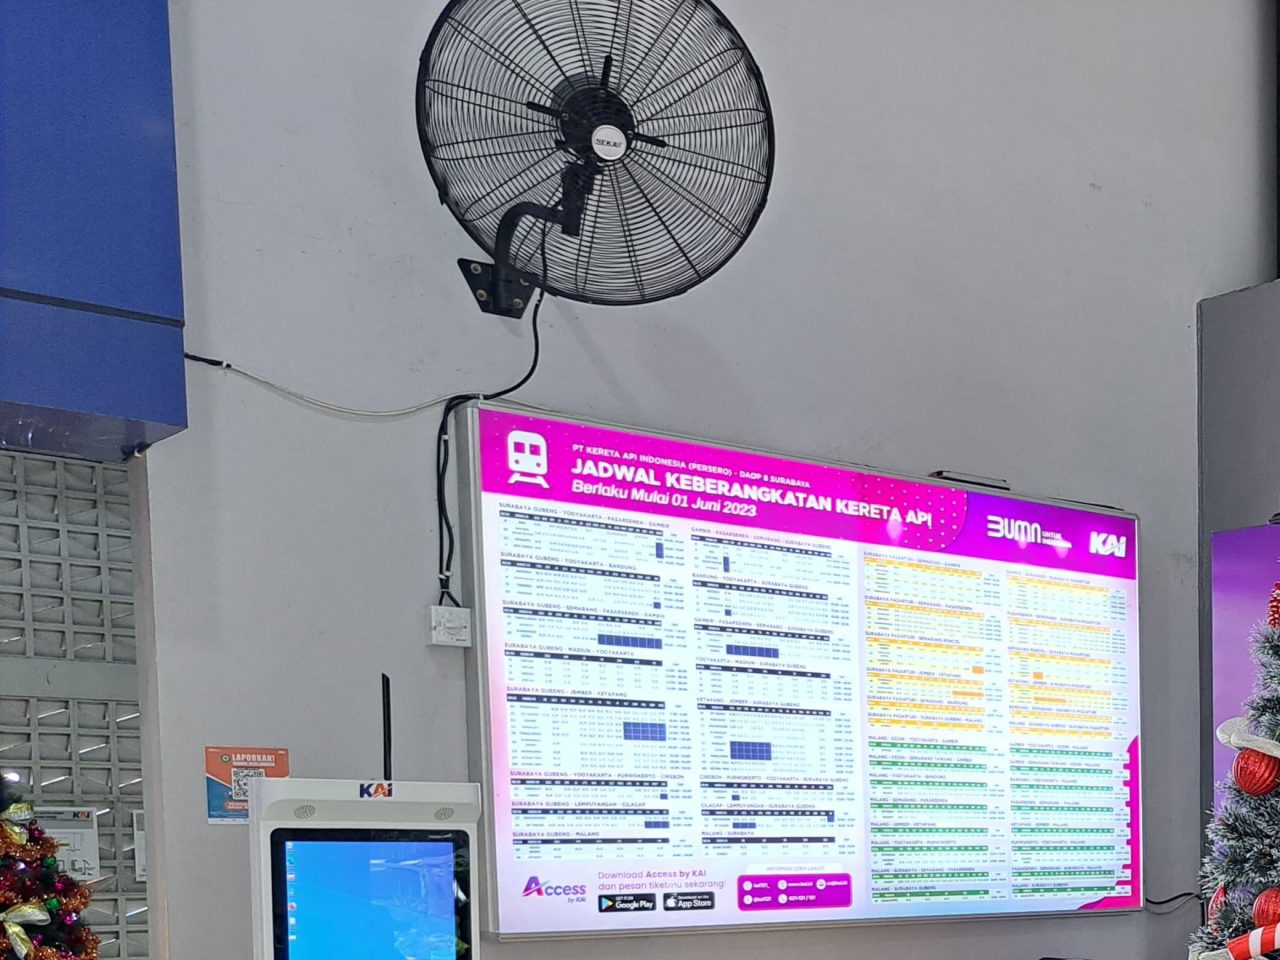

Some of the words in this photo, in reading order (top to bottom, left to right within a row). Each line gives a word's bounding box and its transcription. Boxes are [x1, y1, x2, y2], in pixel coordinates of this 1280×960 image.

[572, 443, 583, 452] PT
[586, 445, 620, 458] KERETA
[623, 451, 637, 461] API
[639, 454, 686, 469] INDONESIA
[689, 462, 733, 476] (PERSERO)
[770, 475, 810, 489] SURABAYA
[571, 456, 660, 487] JADWAL
[666, 471, 832, 513] KEBERANGKATAN
[836, 498, 901, 523] KERETA
[905, 509, 932, 528] API
[572, 478, 627, 500] Berlaku
[632, 487, 669, 506] Mulai
[671, 492, 688, 509] 01
[691, 495, 720, 513] Juni
[723, 500, 756, 518] 2023
[1089, 530, 1127, 559] KAI
[360, 783, 392, 798] KAI
[598, 871, 643, 880] Download
[646, 870, 677, 878] Access
[679, 870, 690, 879] by
[522, 875, 587, 898] Access
[598, 883, 617, 891] dan
[619, 883, 647, 892] pesan
[649, 881, 682, 889] tiketmu
[684, 880, 726, 890] sekarang!
[616, 901, 639, 910] Google
[640, 900, 653, 910] Play
[678, 901, 692, 909] App
